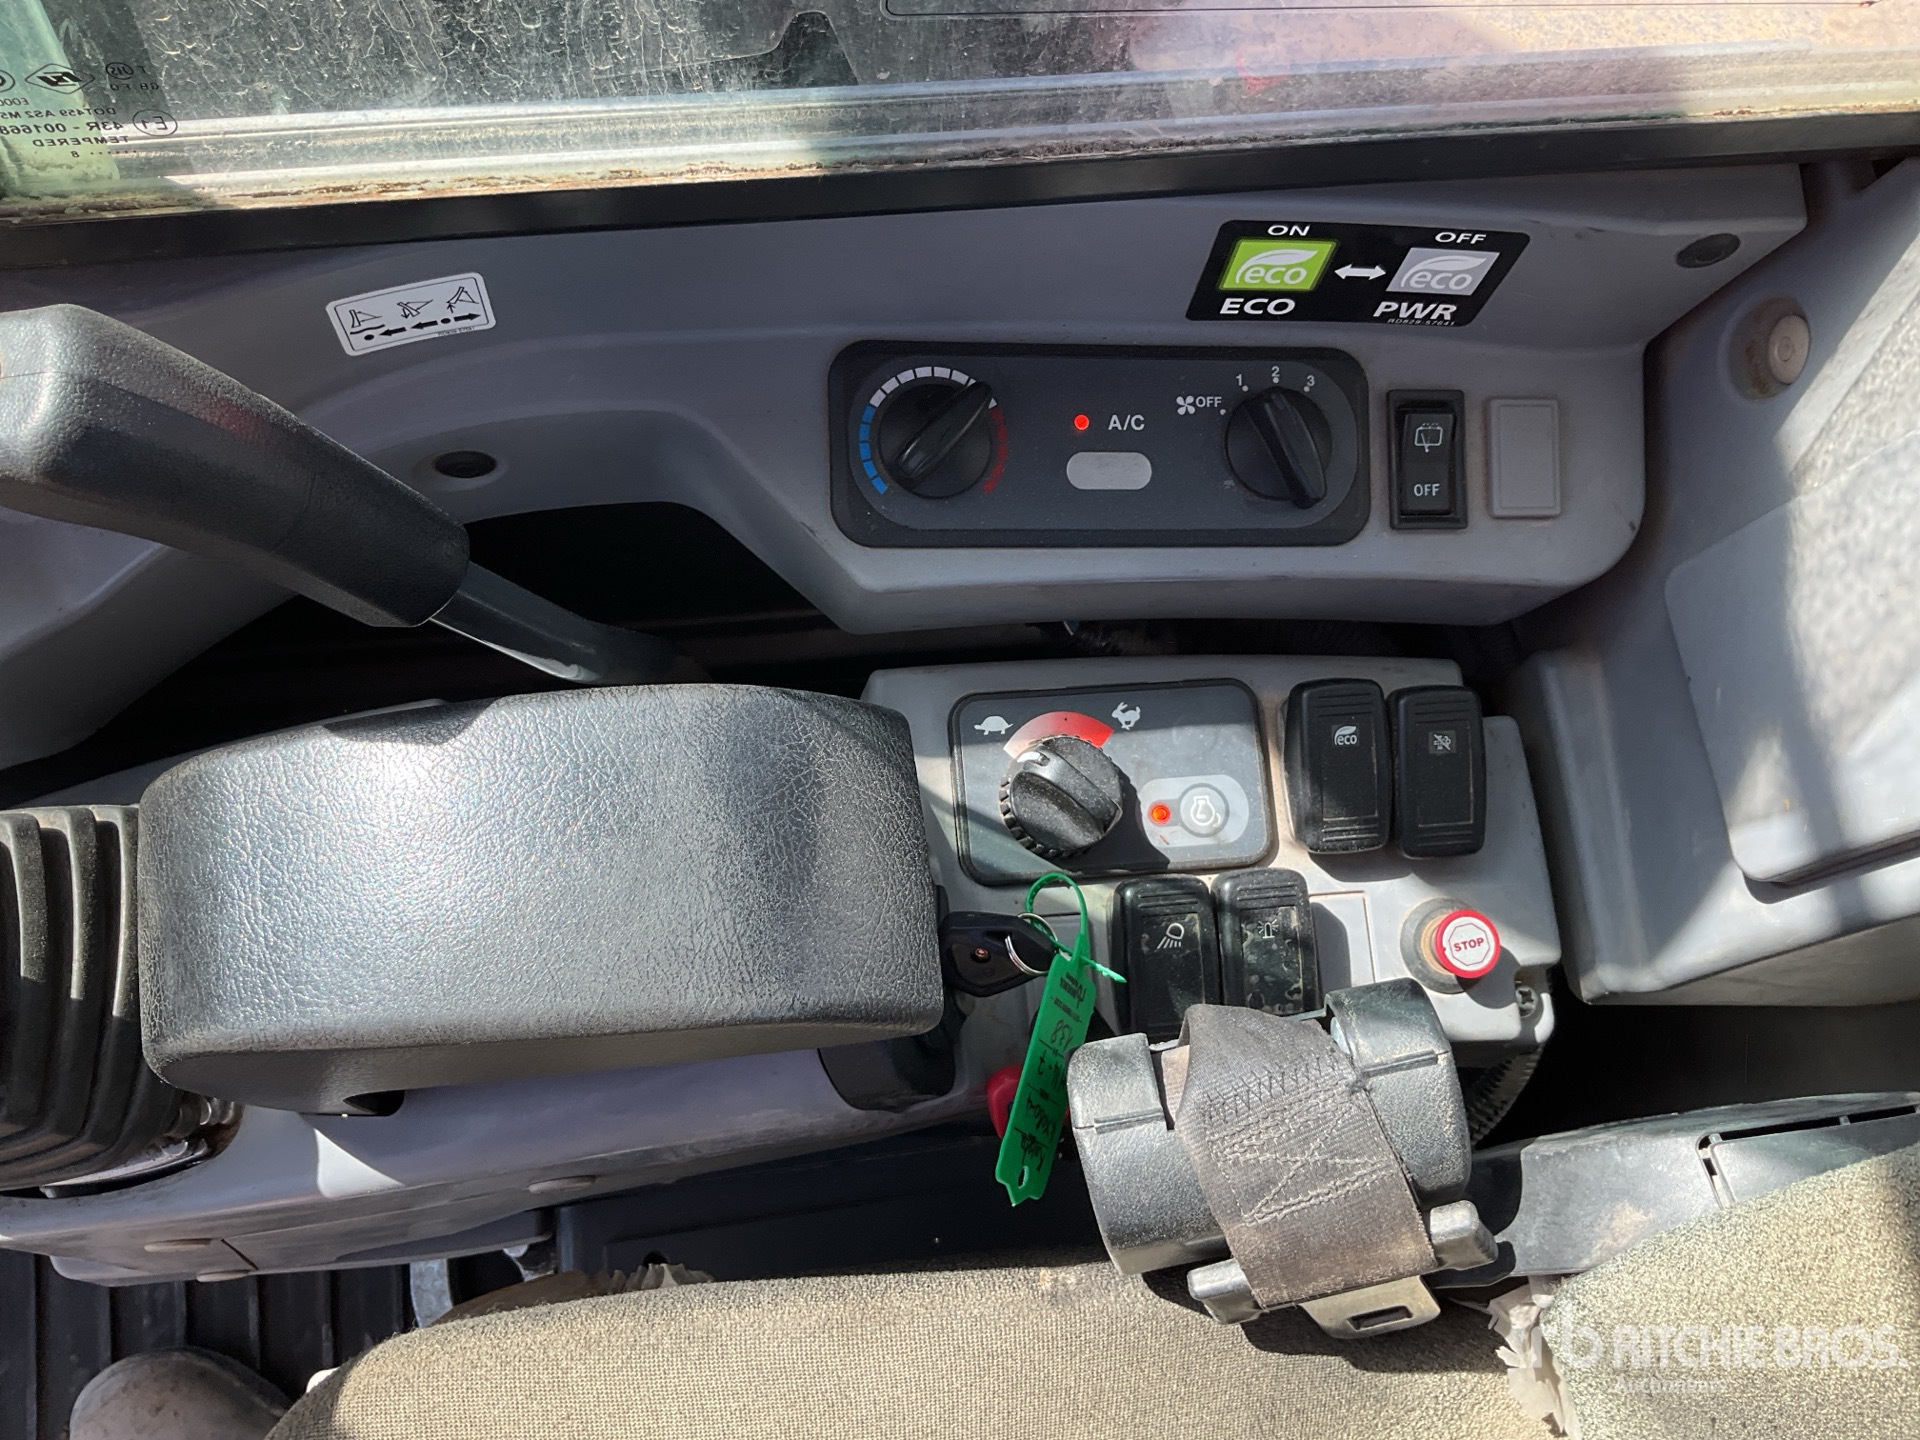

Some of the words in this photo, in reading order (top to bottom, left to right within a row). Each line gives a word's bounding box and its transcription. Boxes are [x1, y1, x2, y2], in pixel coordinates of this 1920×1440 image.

[1267, 225, 1310, 236] ON
[1434, 232, 1487, 244] OFF
[1244, 264, 1307, 285] eco
[1410, 268, 1473, 290] eco
[1219, 297, 1296, 316] ECO
[1373, 301, 1457, 320] PWR
[1271, 366, 1280, 377] 2
[1235, 374, 1243, 386] 1
[1306, 375, 1315, 386] 3
[1195, 396, 1222, 408] OFF
[1108, 414, 1146, 431] A/C
[1413, 483, 1440, 496] OFF
[1337, 734, 1358, 746] eco
[1453, 936, 1485, 951] STOP
